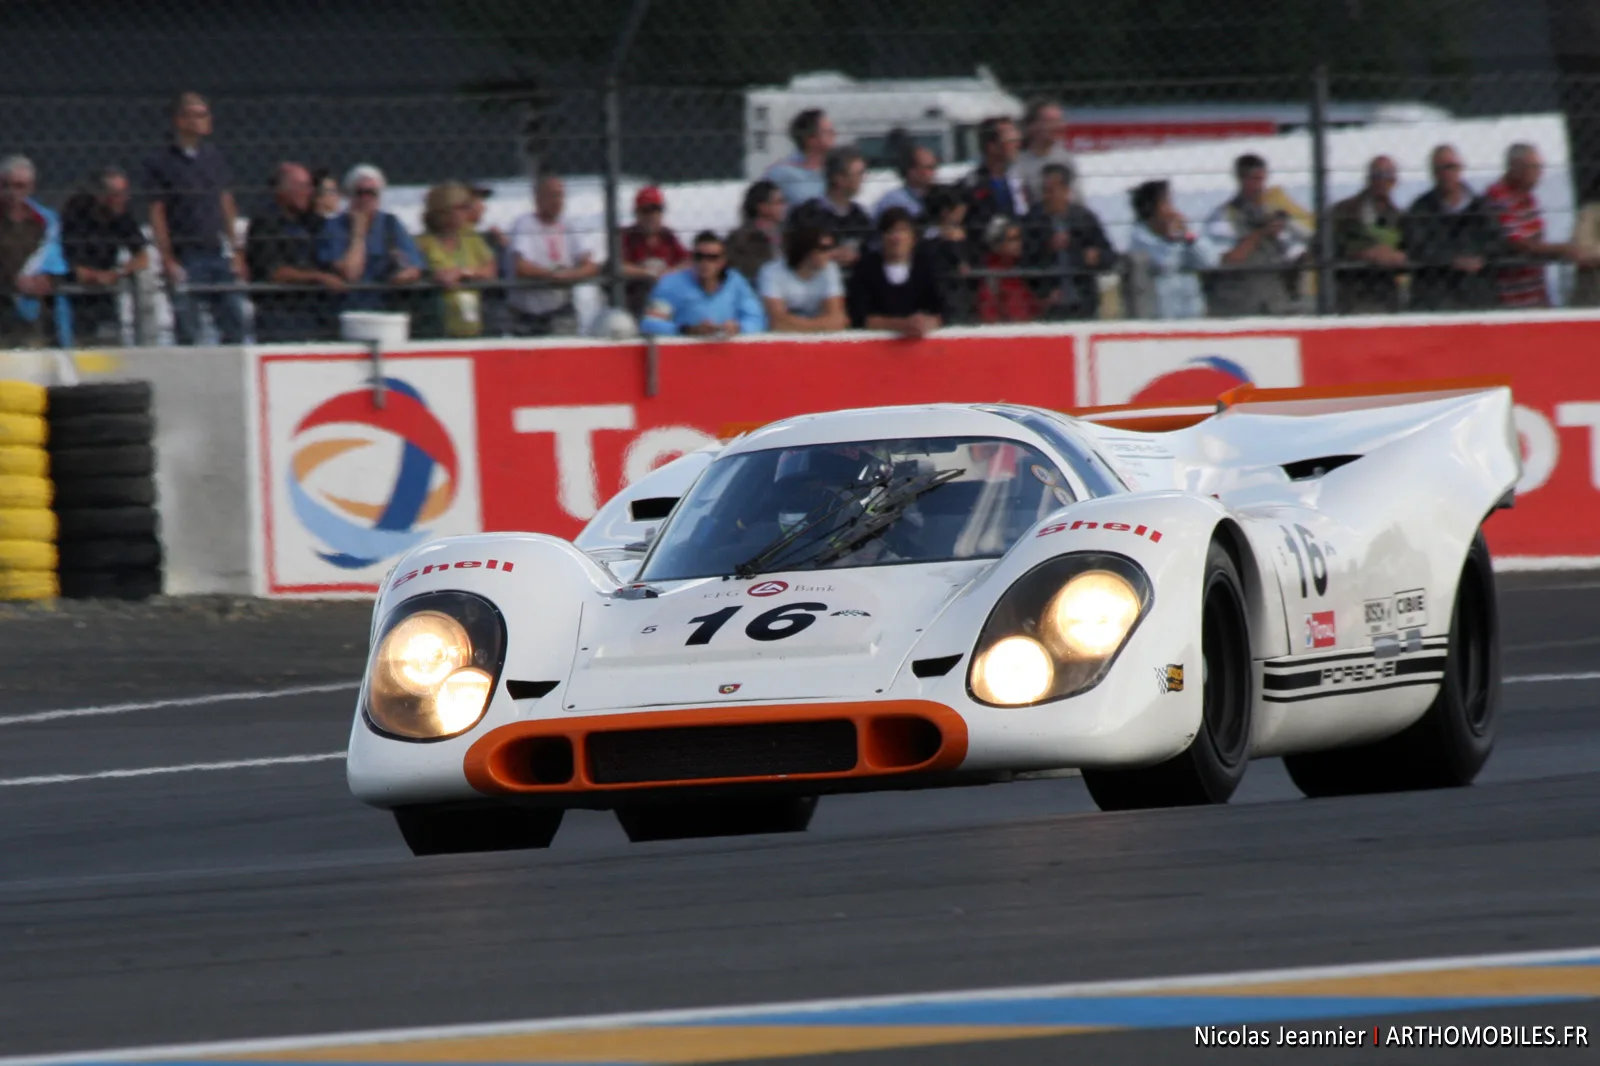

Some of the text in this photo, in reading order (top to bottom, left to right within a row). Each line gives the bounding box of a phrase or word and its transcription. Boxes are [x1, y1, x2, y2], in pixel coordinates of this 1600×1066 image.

[1035, 520, 1163, 543] Shell
[1279, 523, 1328, 598] 16
[391, 559, 515, 591] Shell
[794, 584, 837, 592] Bank
[685, 601, 828, 646] 16
[1321, 660, 1397, 684] PORSCHE
